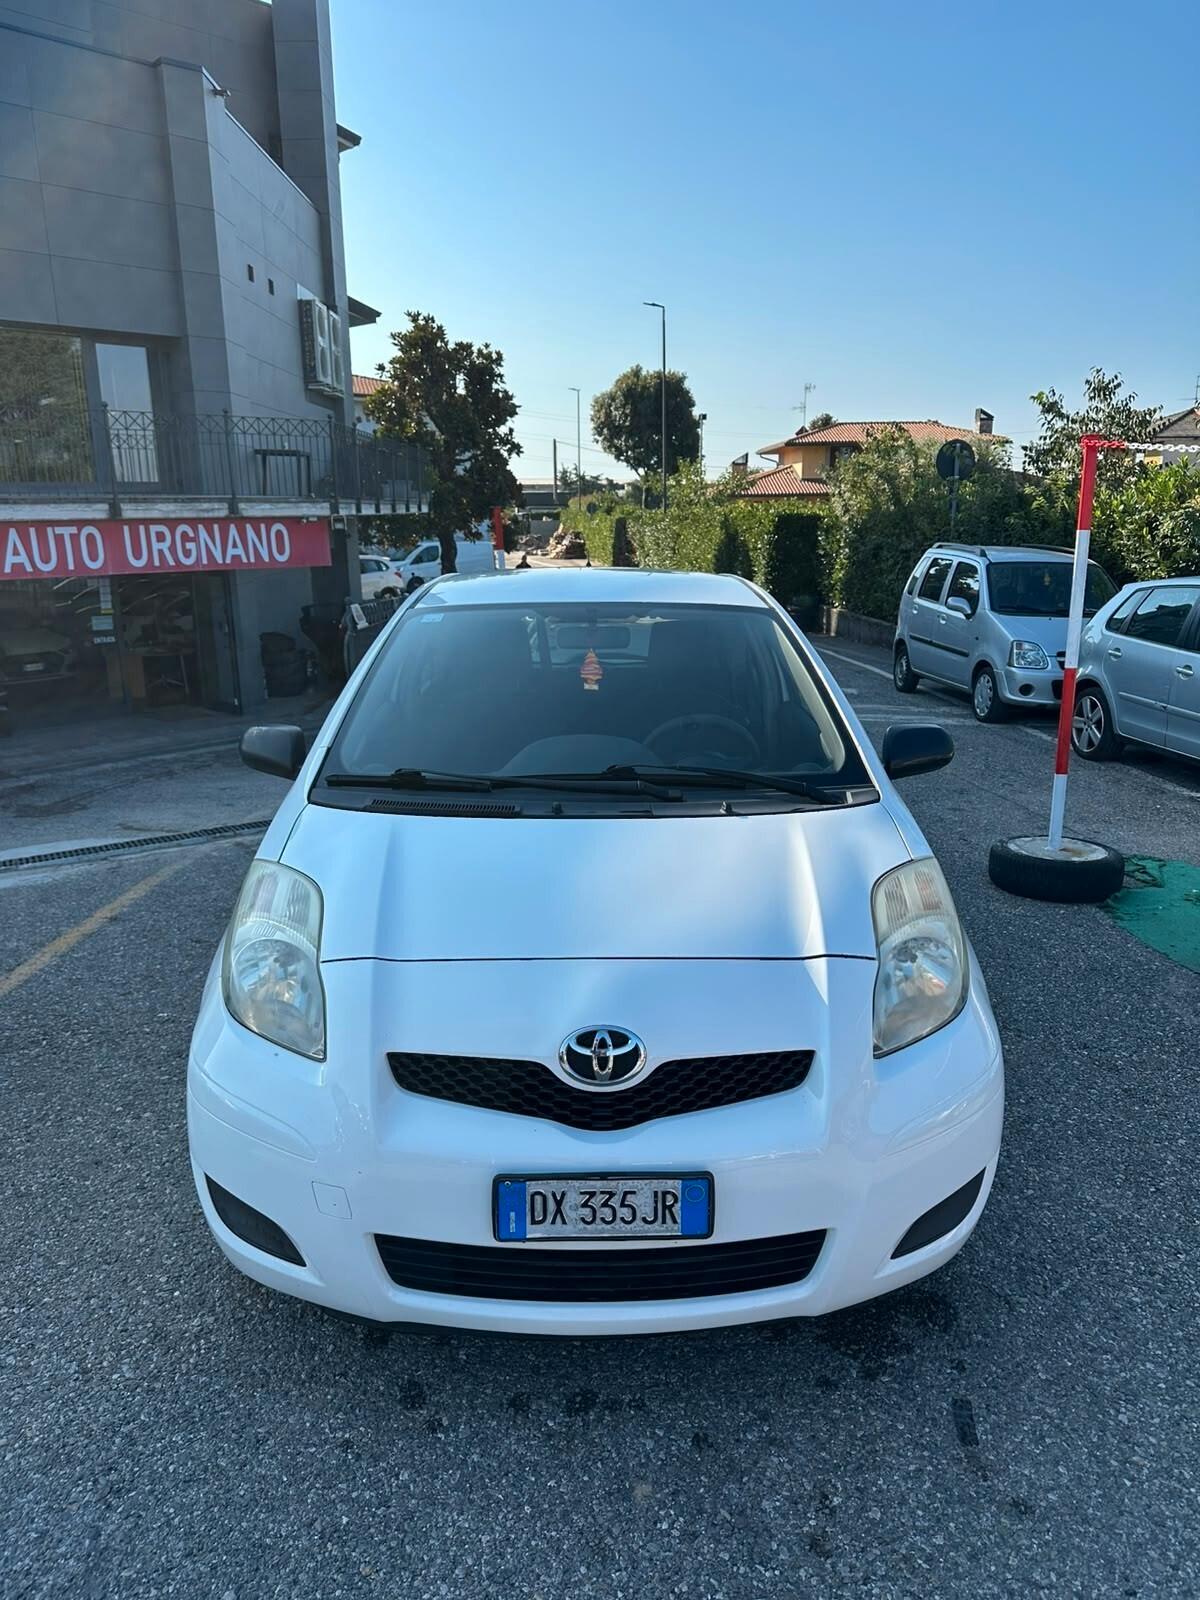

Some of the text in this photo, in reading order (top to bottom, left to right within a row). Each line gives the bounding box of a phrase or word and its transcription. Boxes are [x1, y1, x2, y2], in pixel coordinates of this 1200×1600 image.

[4, 523, 290, 573] AUTO URGNANO
[529, 1190, 567, 1225] DX
